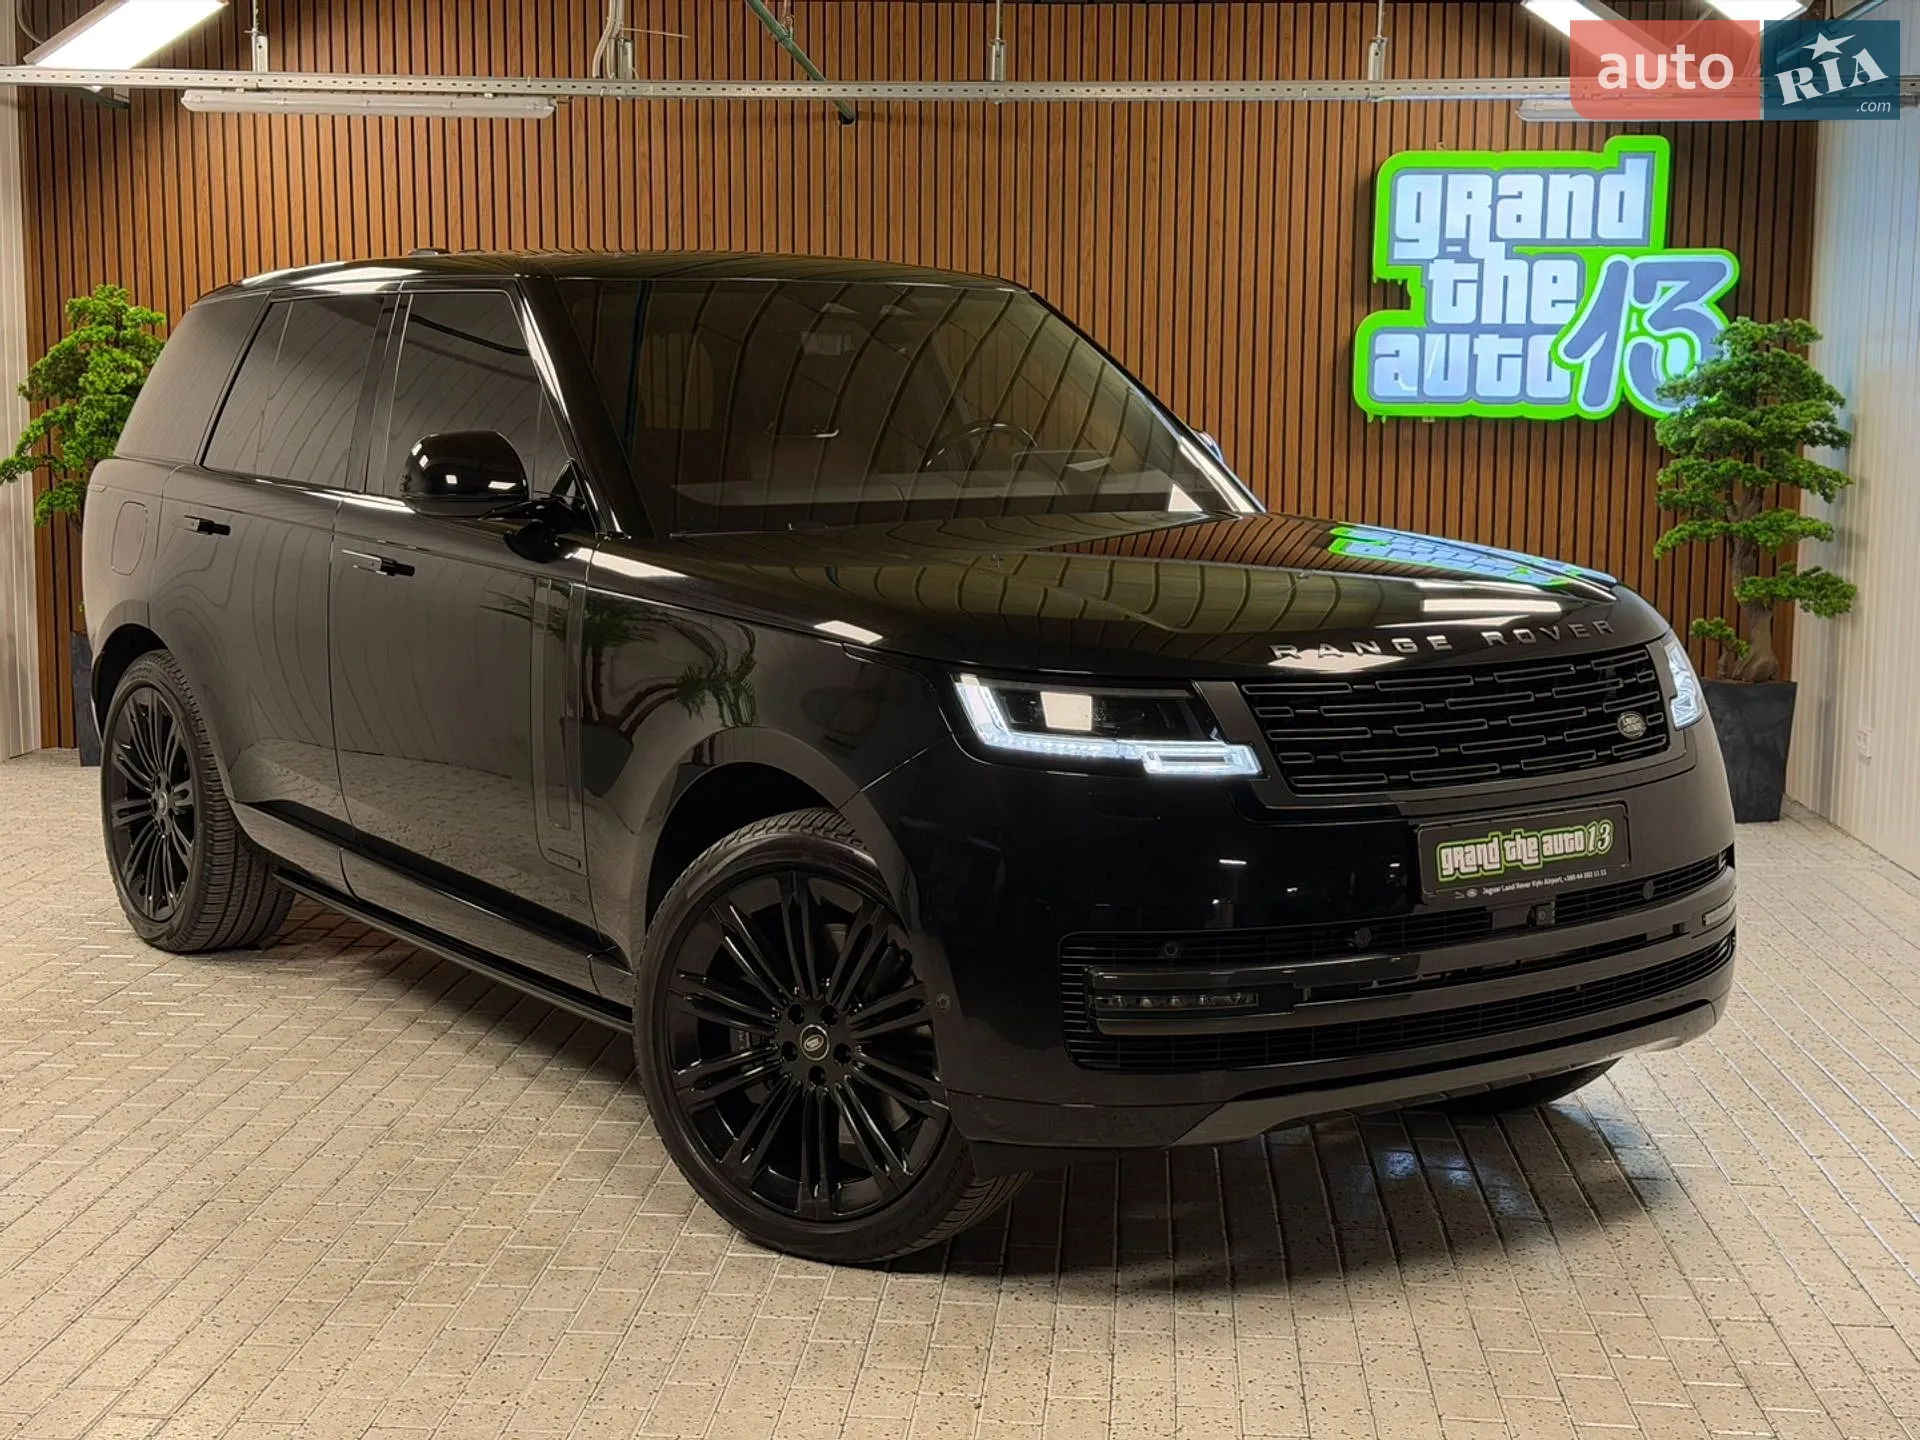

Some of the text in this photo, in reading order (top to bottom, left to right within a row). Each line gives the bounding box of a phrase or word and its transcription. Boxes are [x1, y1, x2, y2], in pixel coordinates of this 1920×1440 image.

[1428, 241, 1580, 325] the
[1368, 254, 1734, 414] auto 13
[1270, 620, 1616, 660] RANGE ROVER
[1504, 834, 1540, 866] the
